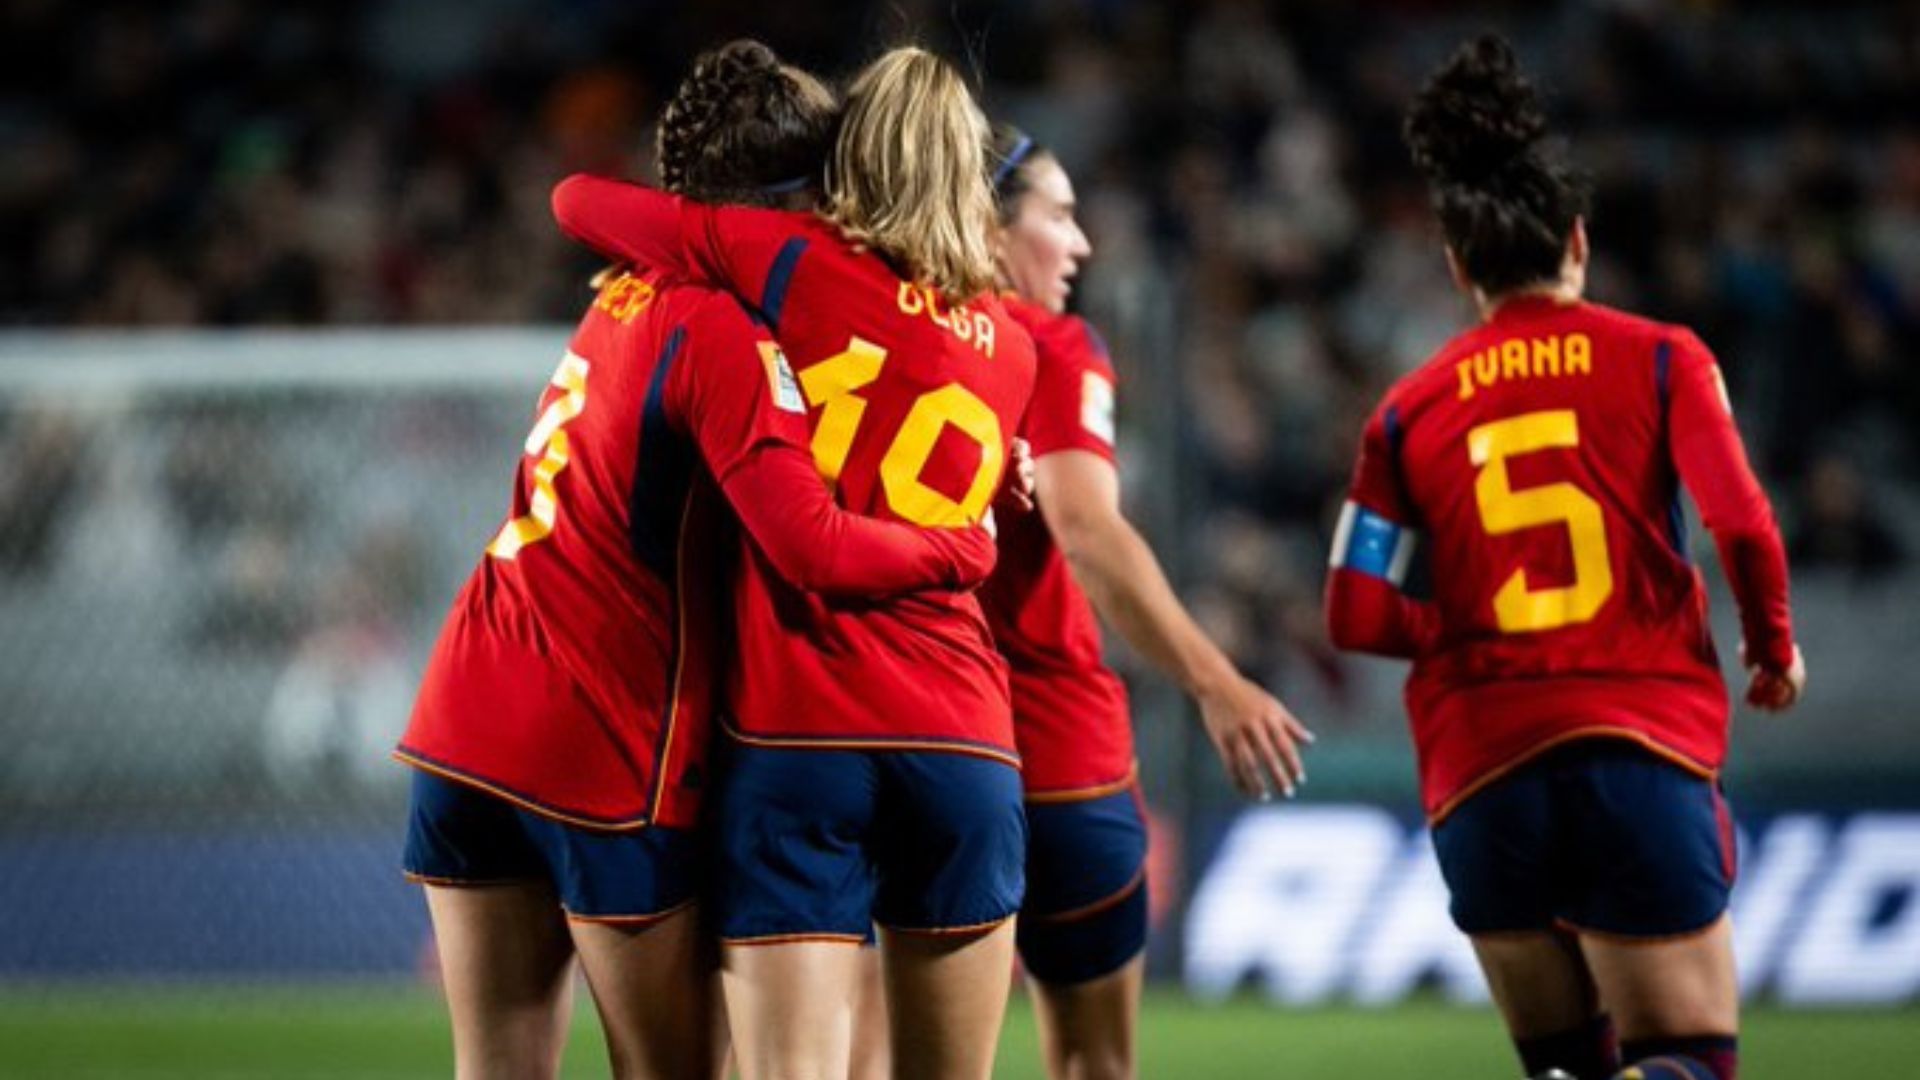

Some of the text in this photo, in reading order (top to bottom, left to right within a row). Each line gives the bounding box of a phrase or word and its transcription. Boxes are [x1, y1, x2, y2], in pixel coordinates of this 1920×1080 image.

[897, 281, 995, 359] OLGA
[1456, 333, 1592, 400] IVANA
[1467, 409, 1613, 633] 5
